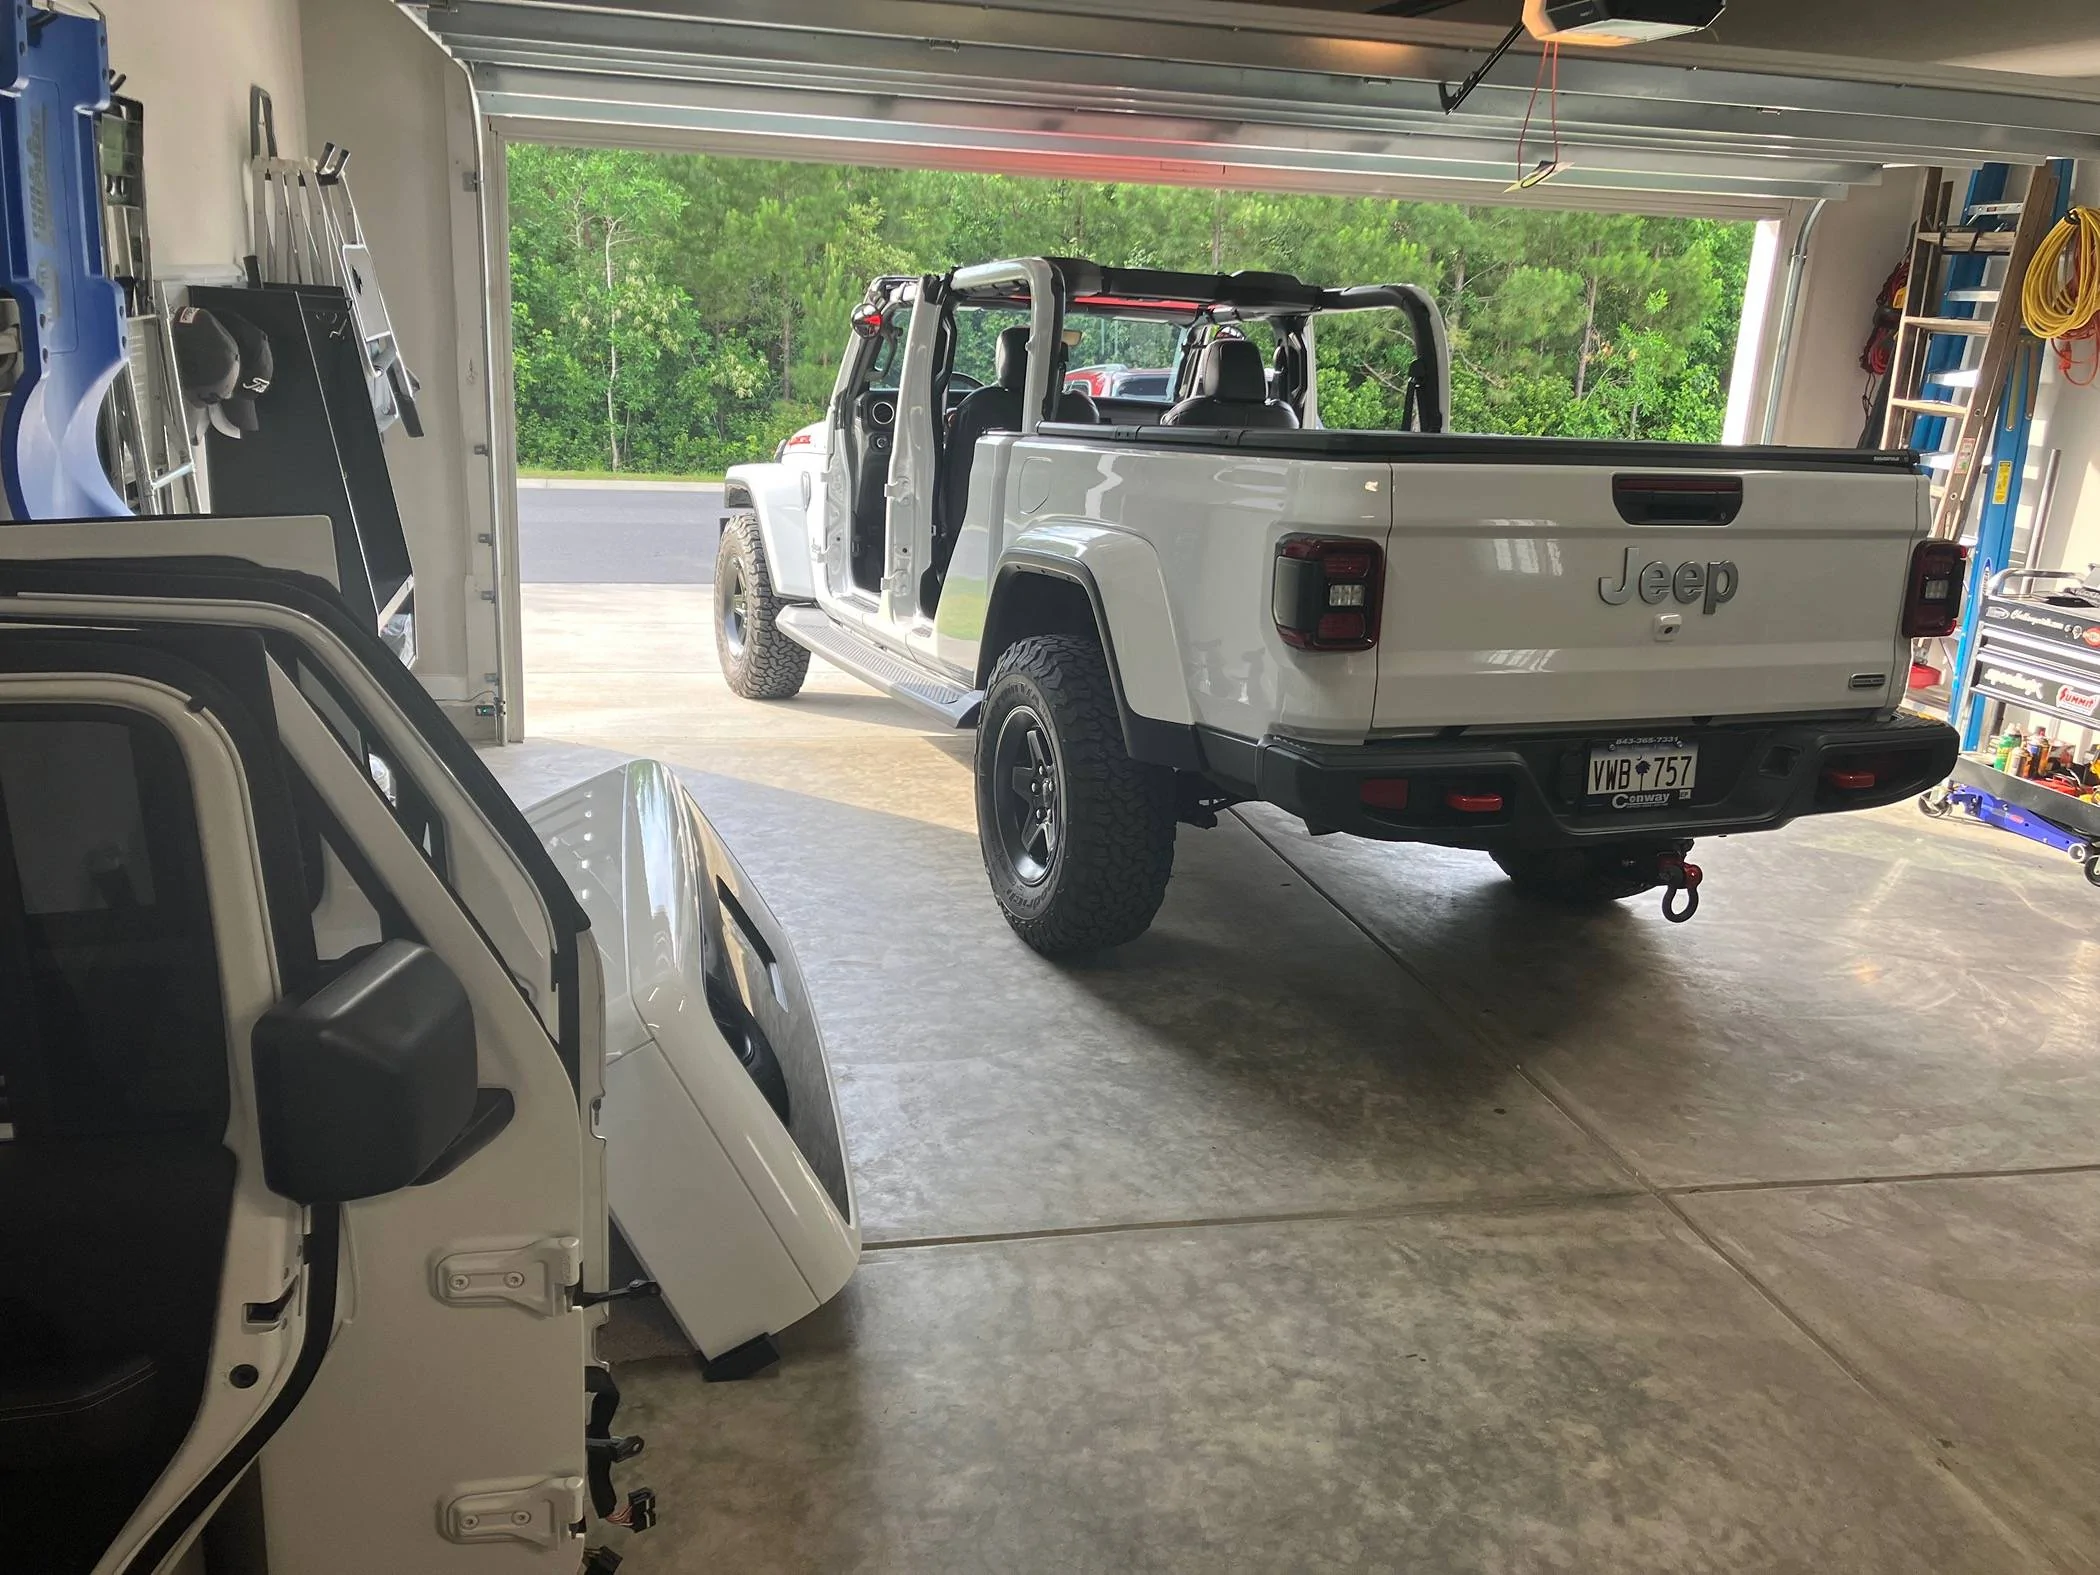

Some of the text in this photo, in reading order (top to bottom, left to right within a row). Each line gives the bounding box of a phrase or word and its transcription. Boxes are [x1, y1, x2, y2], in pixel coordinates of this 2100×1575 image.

[1598, 547, 1739, 615] Jeep
[1594, 756, 1692, 792] VWB 757
[1612, 793, 1670, 809] Conway
